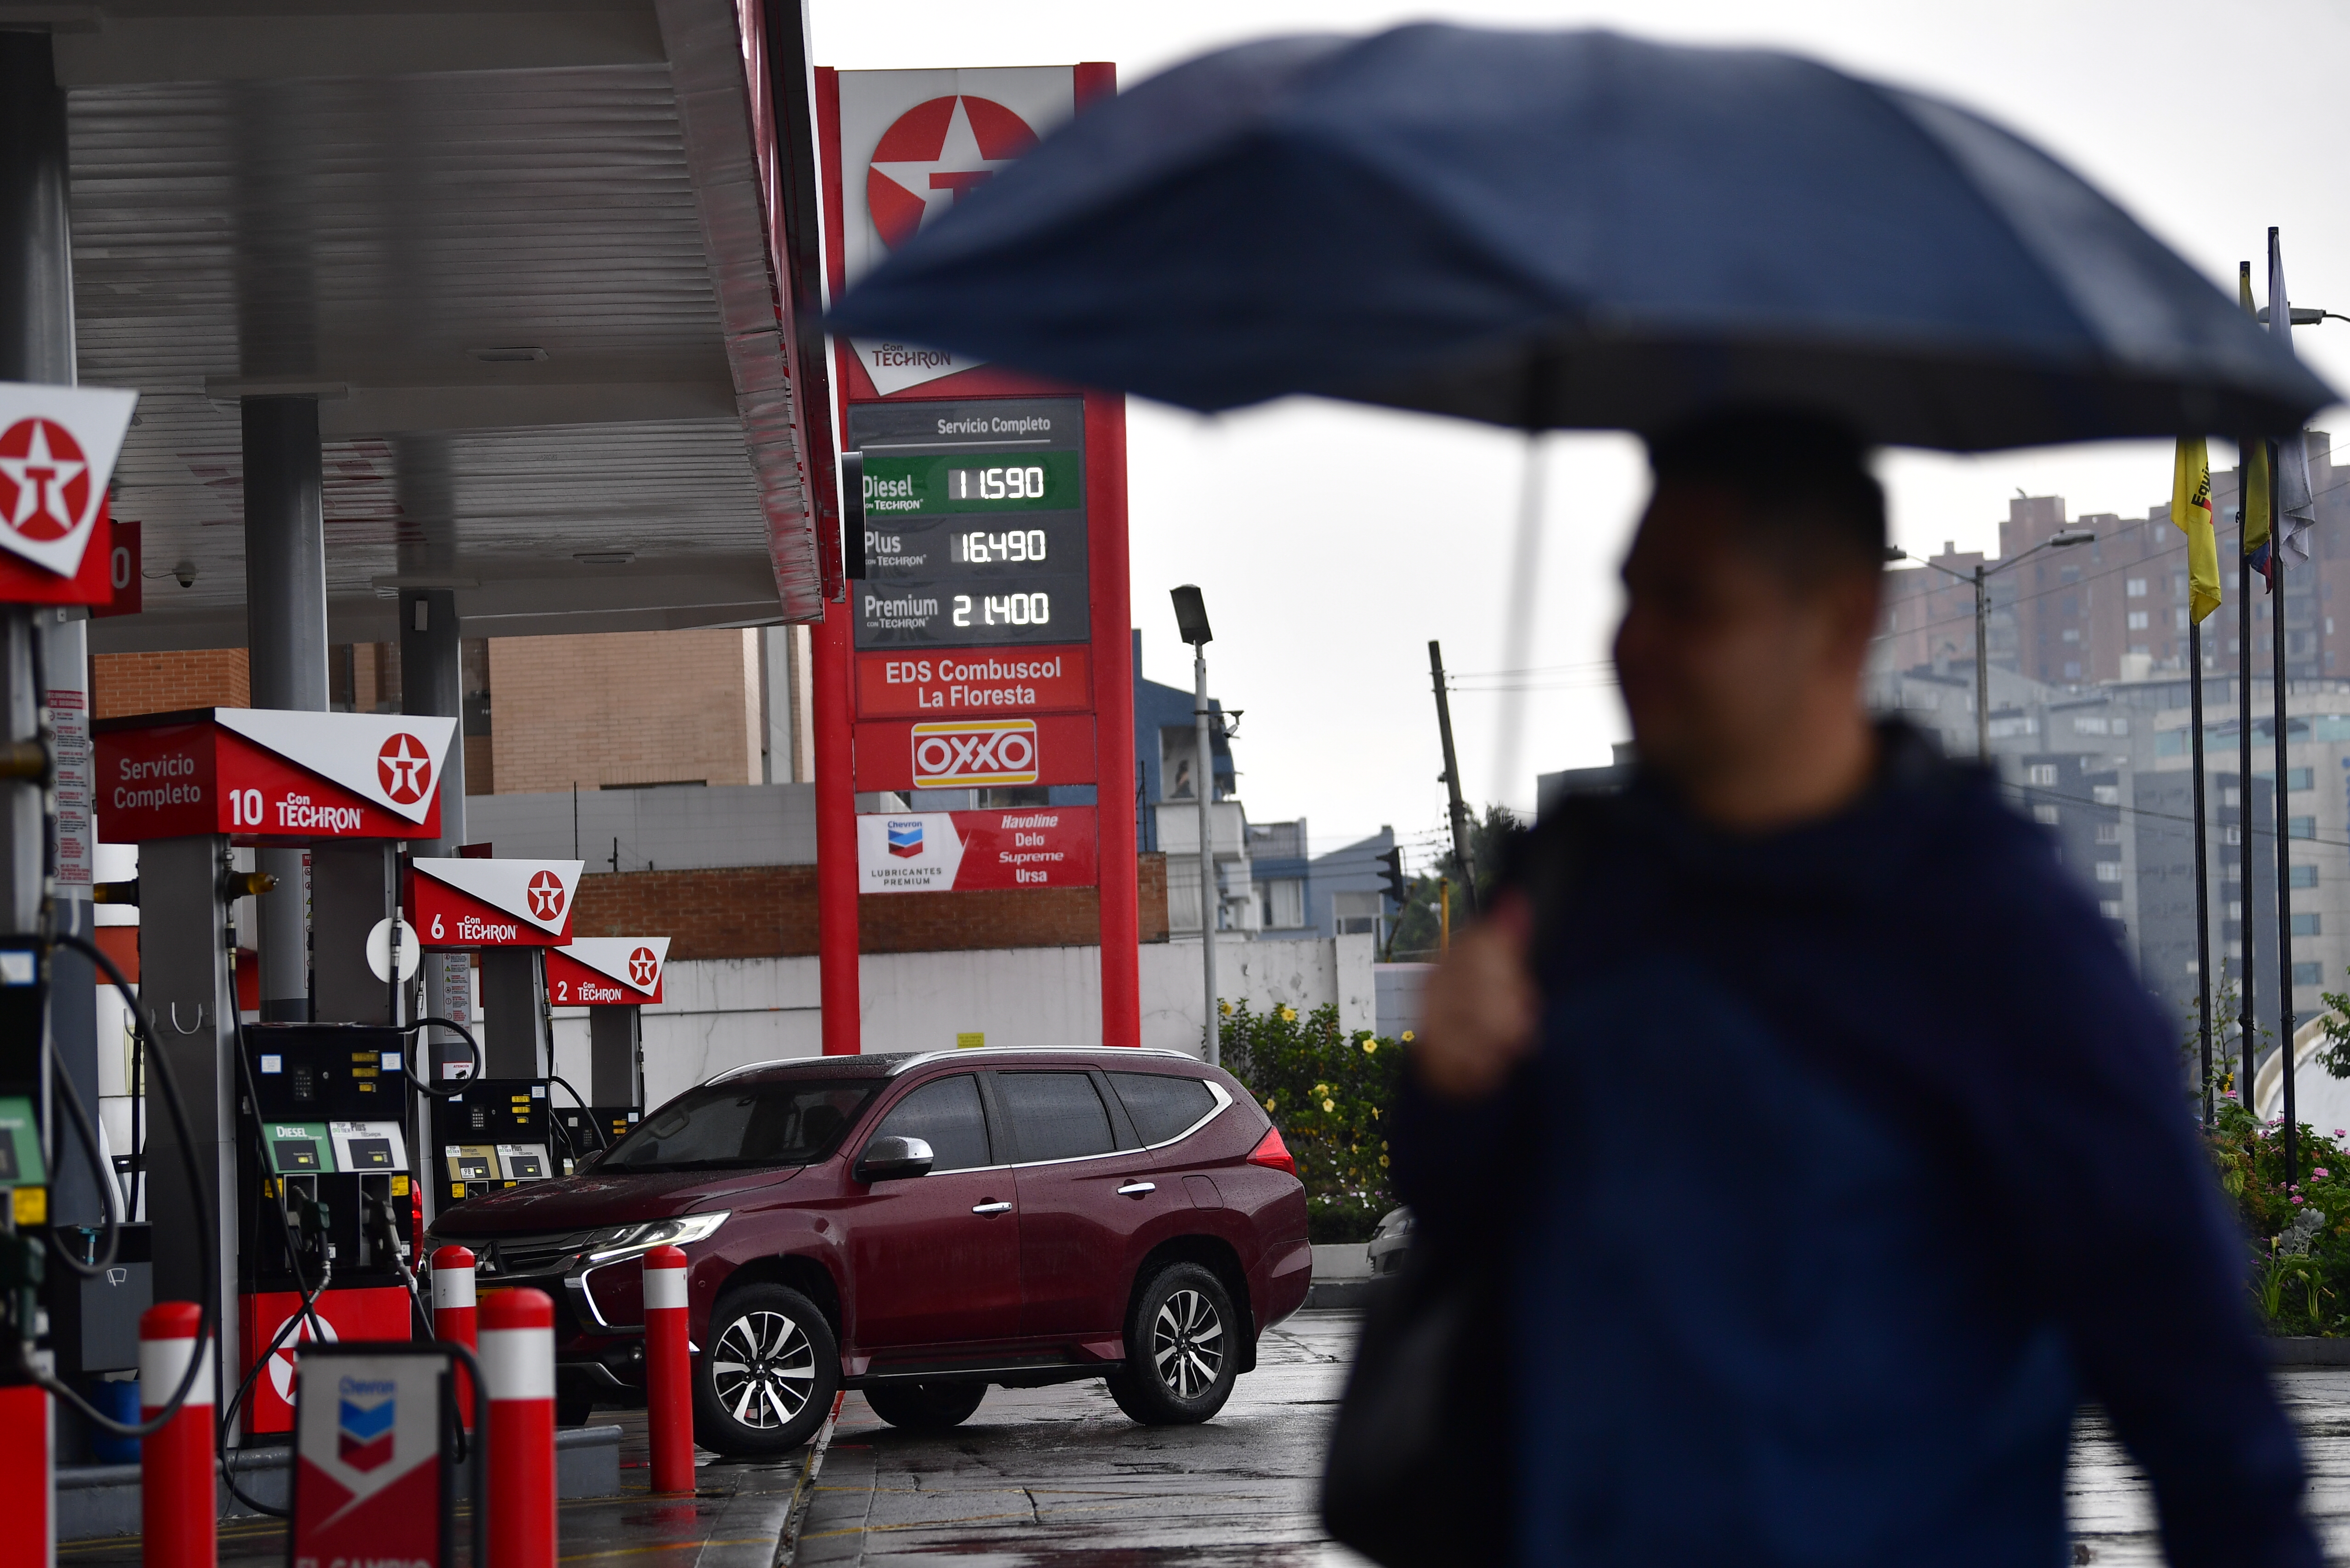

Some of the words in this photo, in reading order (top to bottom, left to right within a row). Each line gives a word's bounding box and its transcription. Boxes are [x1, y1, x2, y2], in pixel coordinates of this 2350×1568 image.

[872, 350, 951, 368] TECHRON
[937, 418, 988, 434] Servicio
[991, 416, 1051, 434] Completo
[863, 474, 913, 497] Diesel
[874, 500, 920, 511] TECHRON
[865, 531, 901, 554] Plus
[962, 530, 1046, 563] 16.490
[877, 556, 923, 567] TECHRON
[865, 593, 938, 618] Premium
[953, 593, 1049, 626] 21.400
[879, 617, 926, 629] TECHRON
[885, 660, 931, 683] EDS
[938, 656, 1061, 682] Combuscol
[918, 686, 943, 708] La
[950, 684, 1035, 707] Floresta
[917, 734, 1032, 775] OXXO
[120, 754, 194, 780] Servicio
[114, 783, 201, 811] Completo
[287, 792, 310, 805] Con
[229, 788, 263, 826] 10
[275, 801, 361, 833] TECHRON
[887, 820, 922, 828] Chevron
[1001, 813, 1058, 829] Havoline
[1014, 832, 1045, 846] Delo
[998, 851, 1064, 865] Supreme
[871, 867, 942, 877] LUBRICANTES
[1015, 868, 1047, 883] Ursa
[884, 877, 930, 886] PREMIUM
[431, 913, 445, 939] 6
[464, 915, 481, 924] Con
[457, 922, 516, 942] TECHRON
[557, 981, 568, 1001] 2
[577, 987, 621, 1003] TECHRON
[276, 1126, 308, 1137] DIESEL
[350, 1122, 366, 1131] Plus
